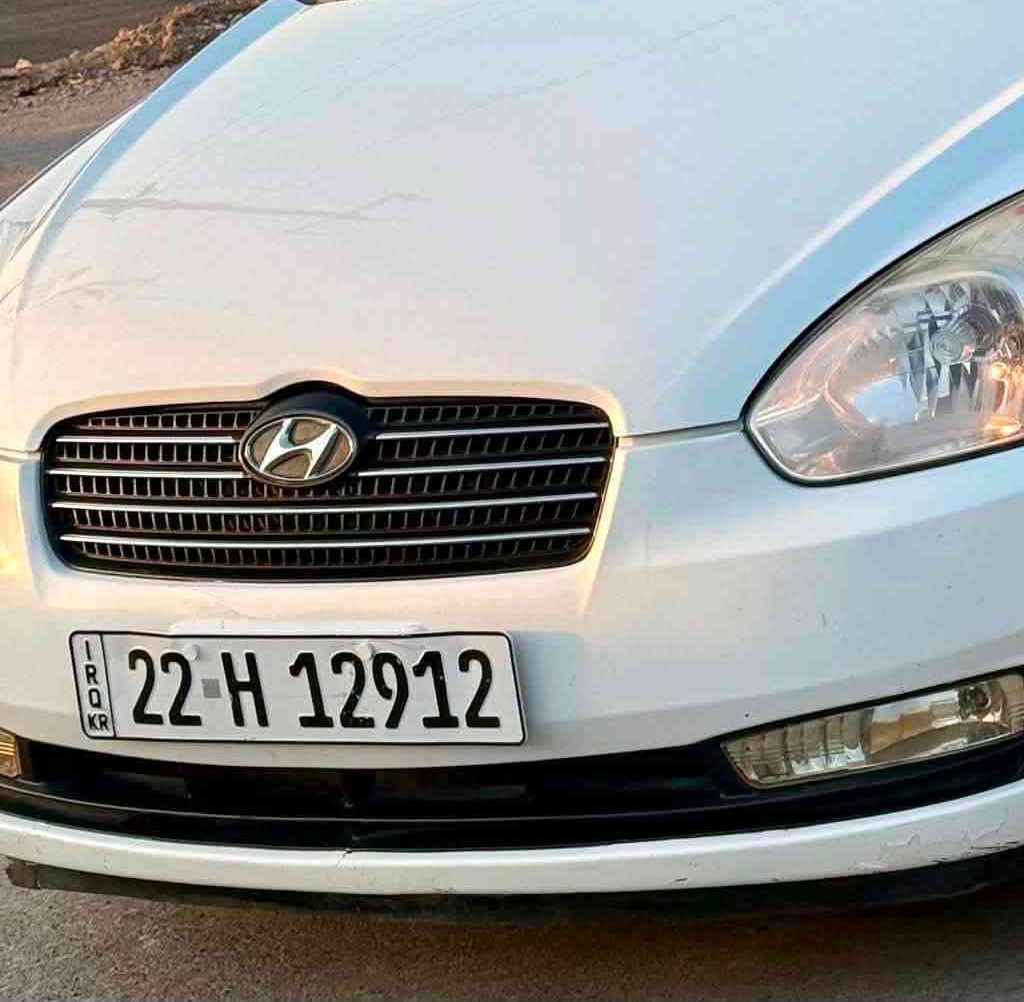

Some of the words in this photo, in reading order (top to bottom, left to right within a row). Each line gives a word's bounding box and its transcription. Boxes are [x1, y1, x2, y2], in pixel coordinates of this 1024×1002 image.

[128, 649, 202, 726] 22
[221, 651, 271, 727] H
[289, 649, 501, 729] 12912
[88, 713, 109, 730] KR
